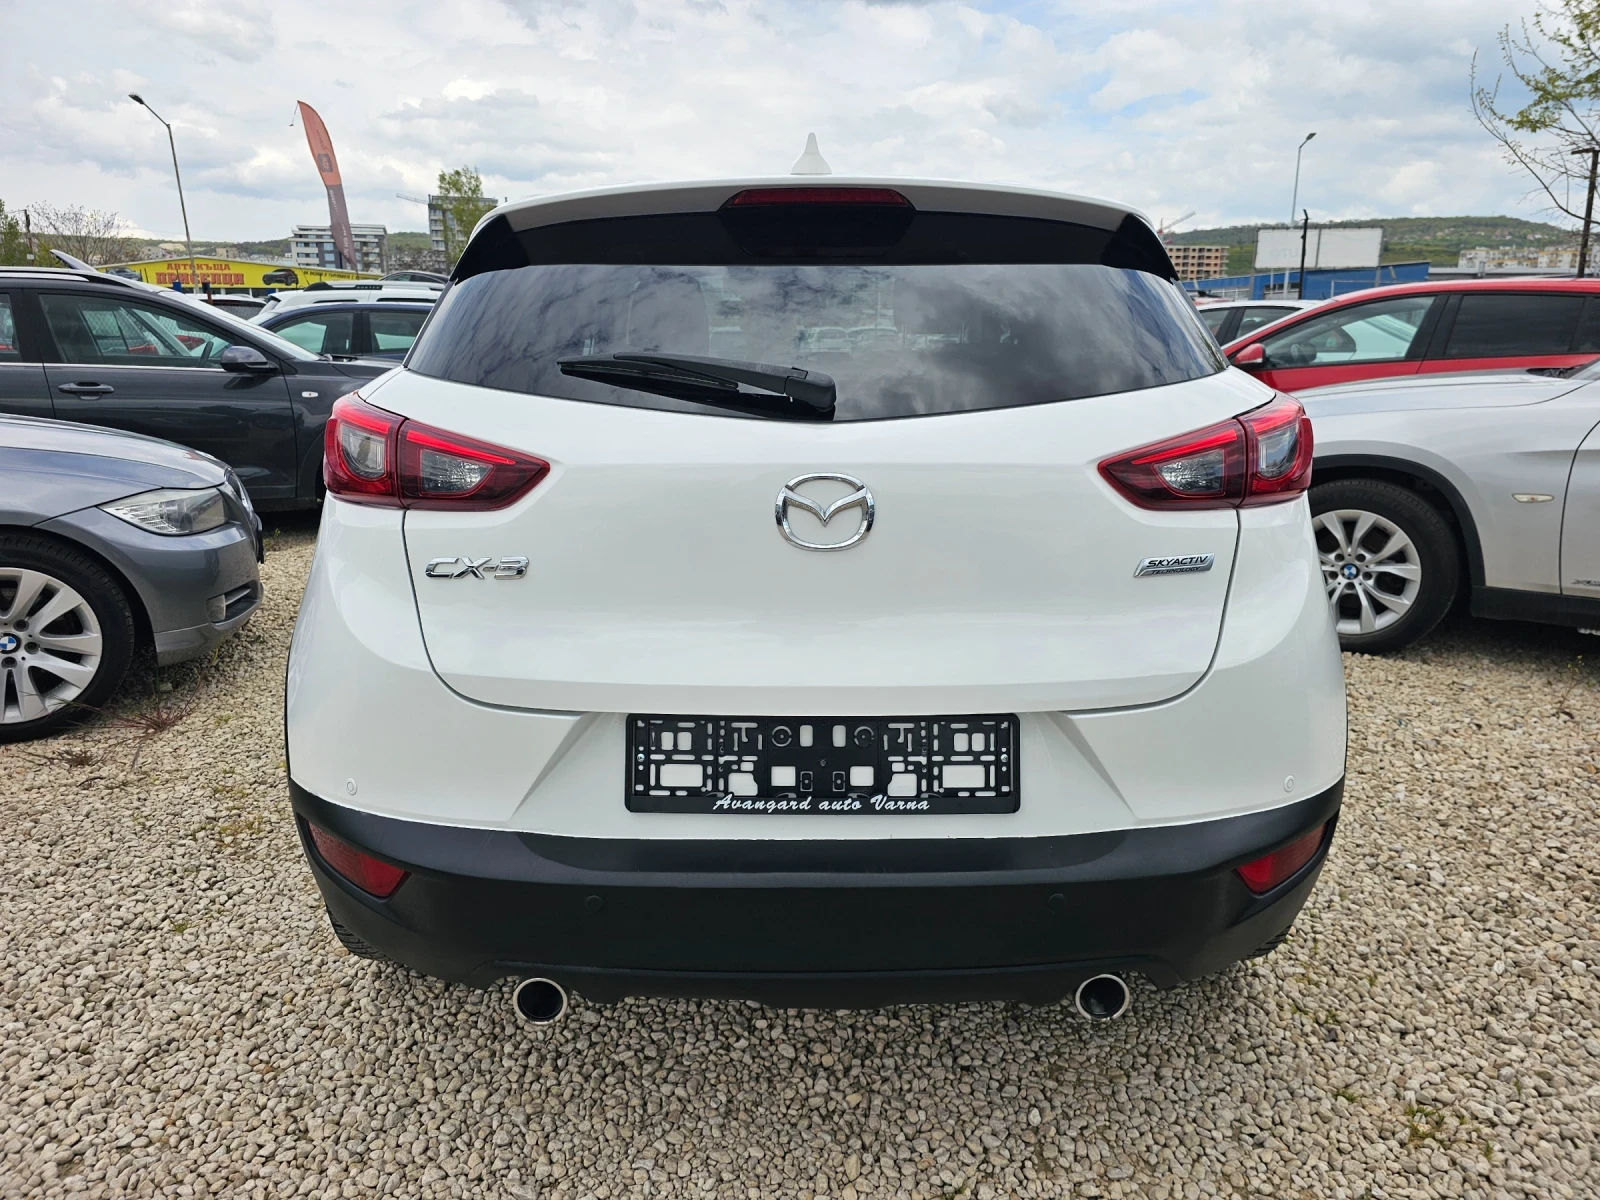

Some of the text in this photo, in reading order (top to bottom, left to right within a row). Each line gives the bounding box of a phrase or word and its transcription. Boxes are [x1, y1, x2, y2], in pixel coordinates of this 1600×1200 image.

[425, 556, 530, 580] CX-3
[1147, 556, 1209, 567] SKYACTIV
[1151, 567, 1201, 575] TECHNOLOGY
[712, 794, 930, 813] Avangard auto Varna
